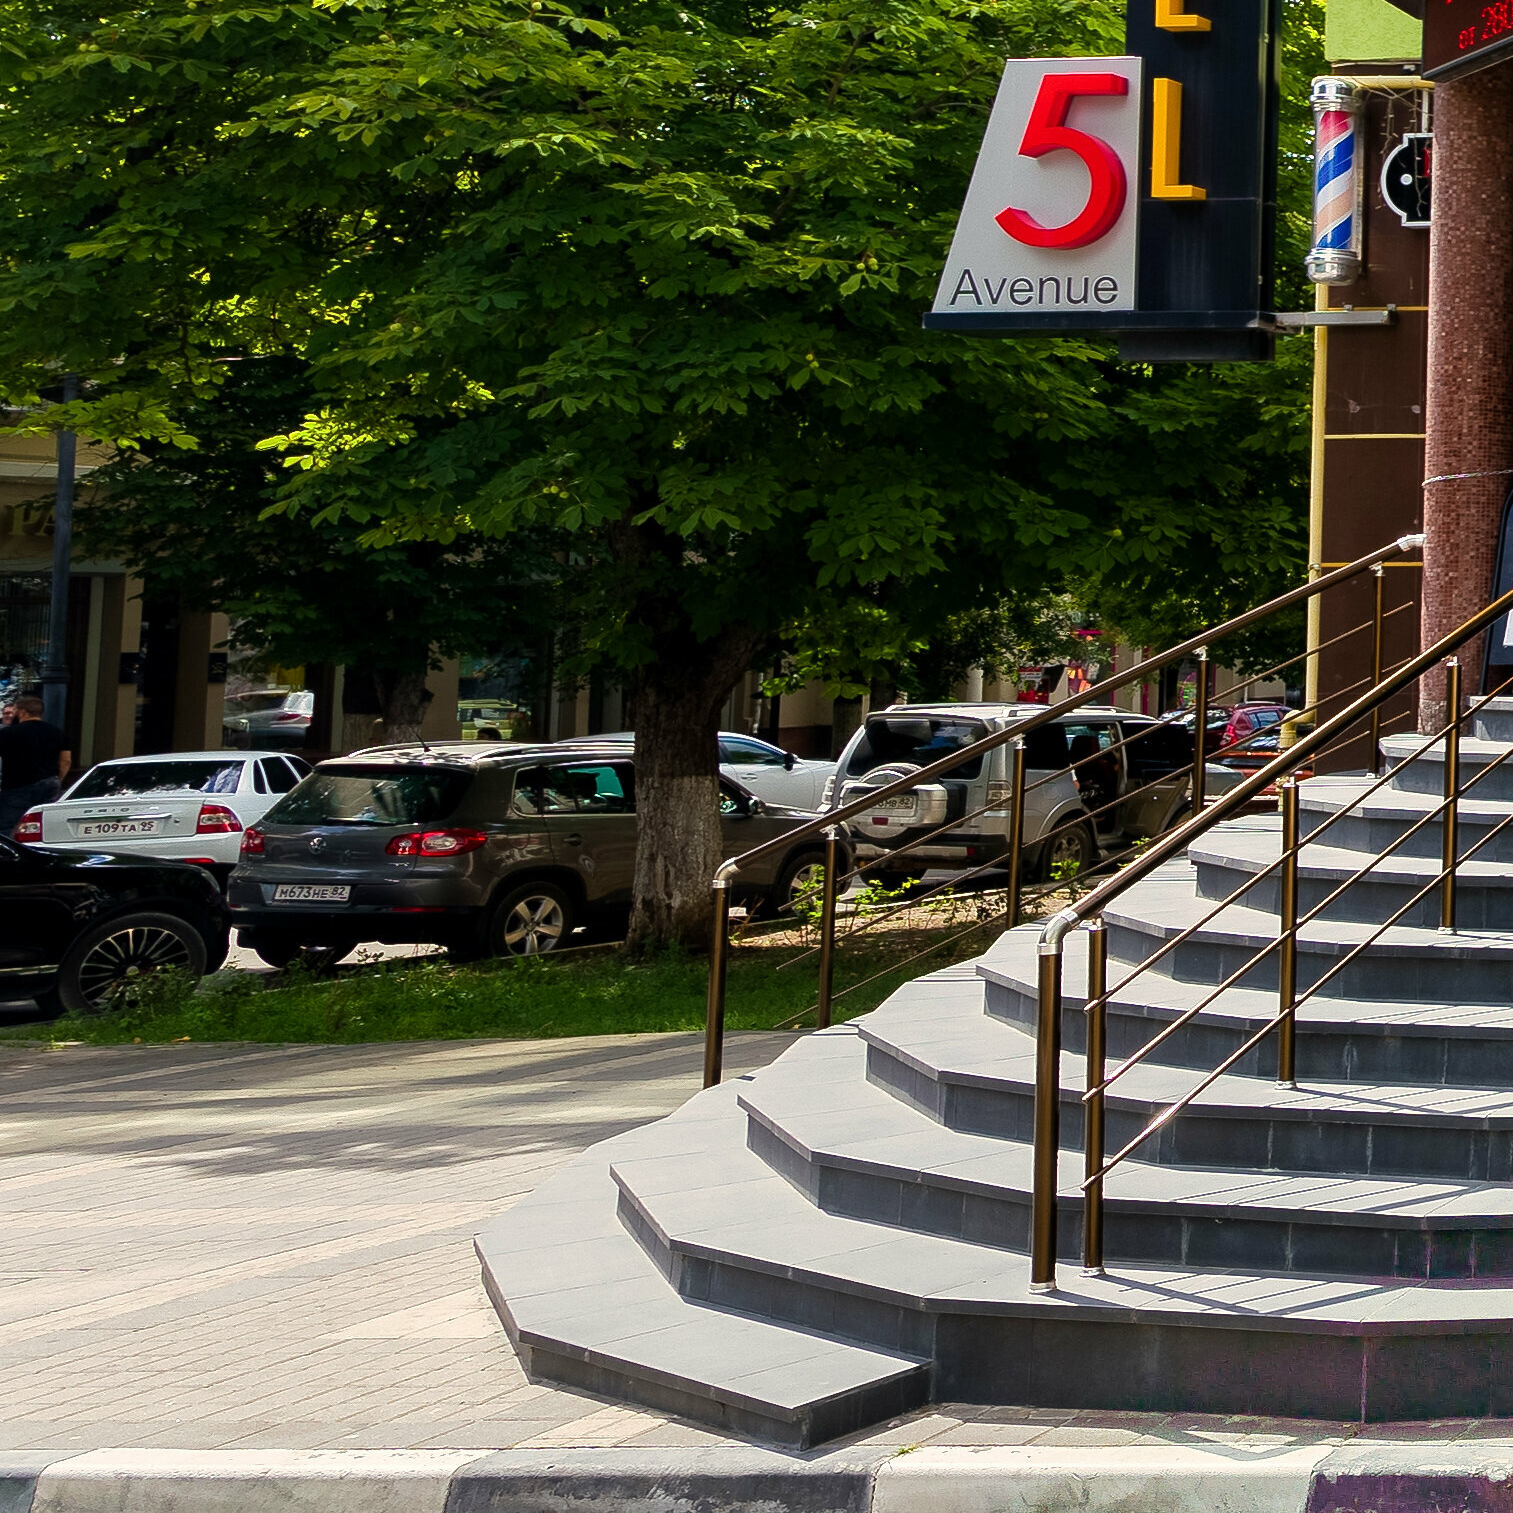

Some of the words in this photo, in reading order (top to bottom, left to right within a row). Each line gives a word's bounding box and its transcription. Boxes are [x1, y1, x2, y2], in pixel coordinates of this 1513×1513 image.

[1458, 28, 1477, 50] от
[994, 71, 1129, 251] 5
[949, 268, 1119, 306] Avenue
